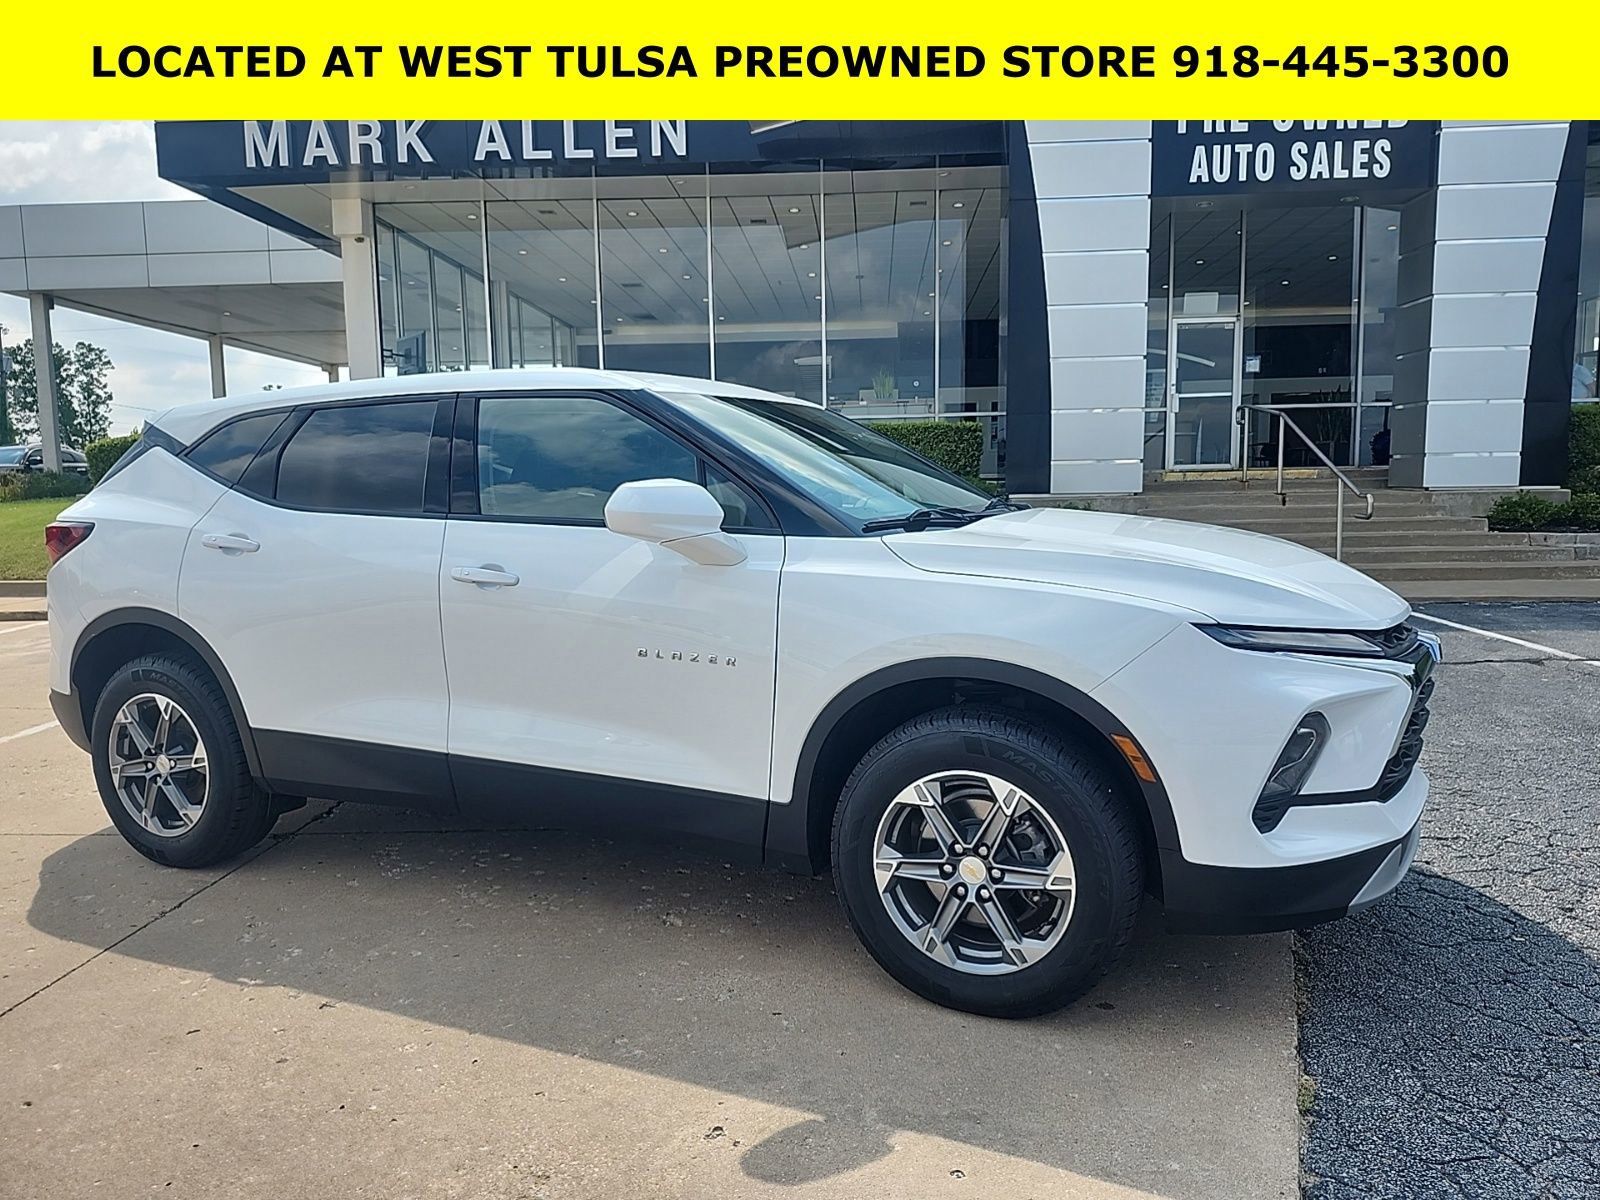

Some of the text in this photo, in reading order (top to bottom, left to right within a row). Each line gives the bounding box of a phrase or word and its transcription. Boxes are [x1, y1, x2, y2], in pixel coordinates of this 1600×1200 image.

[243, 120, 688, 168] MARK ALLEN
[1189, 138, 1392, 183] AUTO SALES
[637, 647, 737, 667] BLAZER
